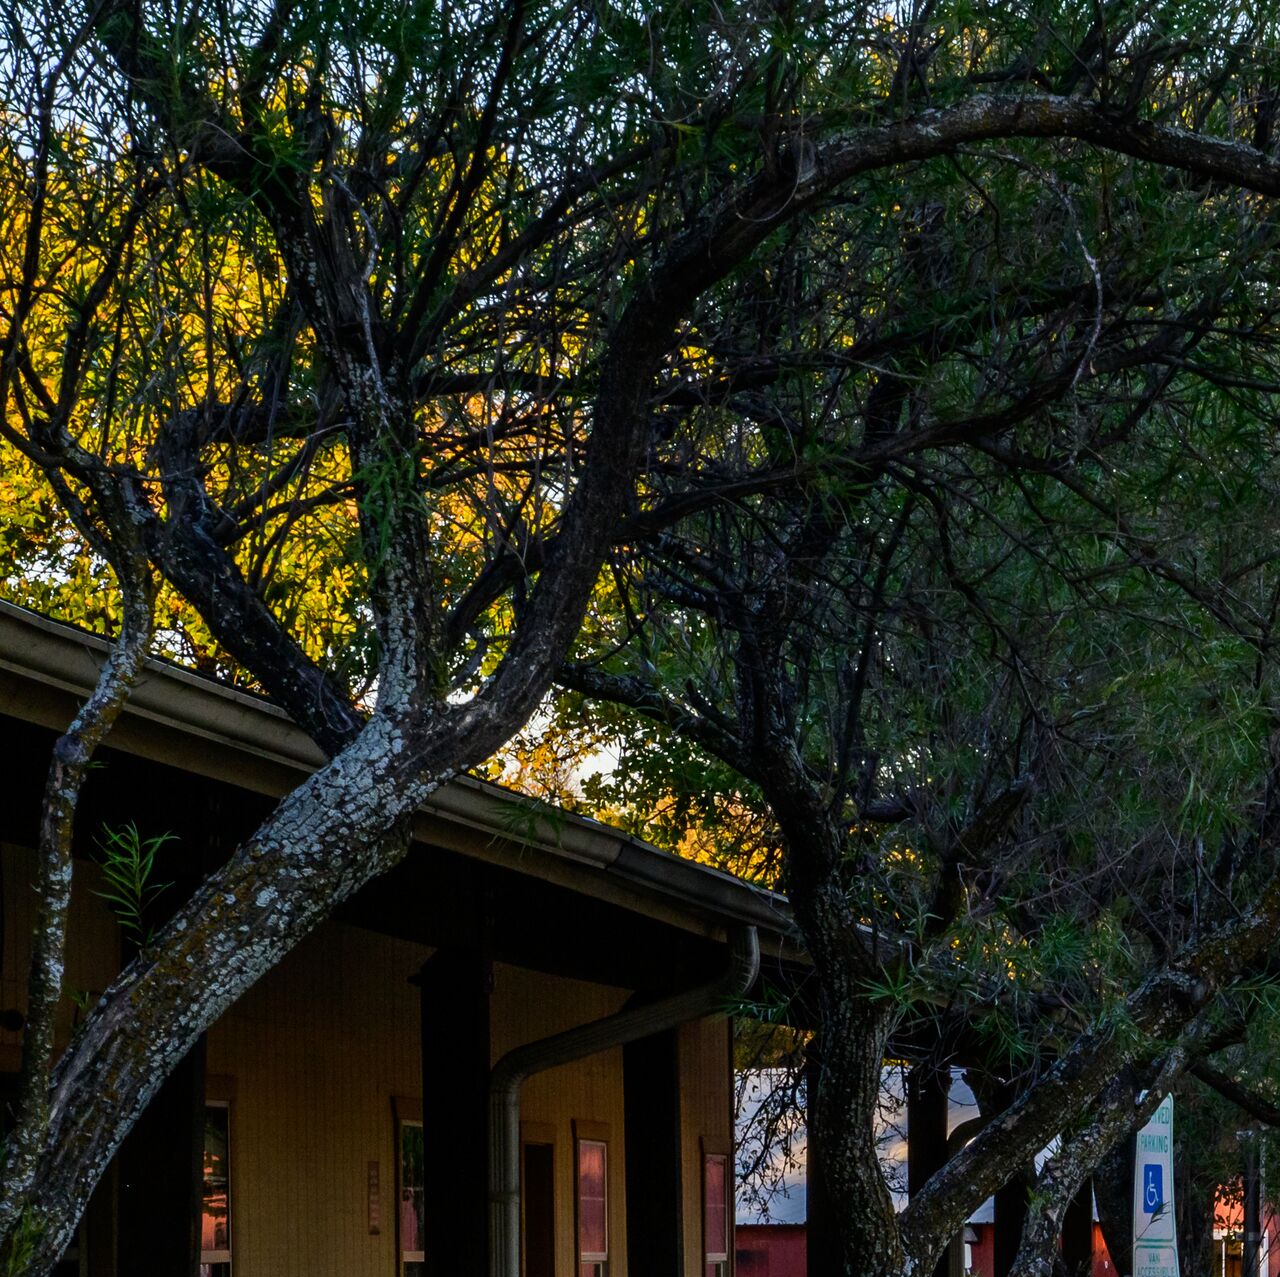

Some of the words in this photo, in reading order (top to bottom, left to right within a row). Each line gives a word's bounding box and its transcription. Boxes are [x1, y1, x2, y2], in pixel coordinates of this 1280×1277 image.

[1141, 1135, 1168, 1153] PARKING
[1148, 1253, 1160, 1264] VAN
[1136, 1266, 1176, 1277] ACCESSIBLE
